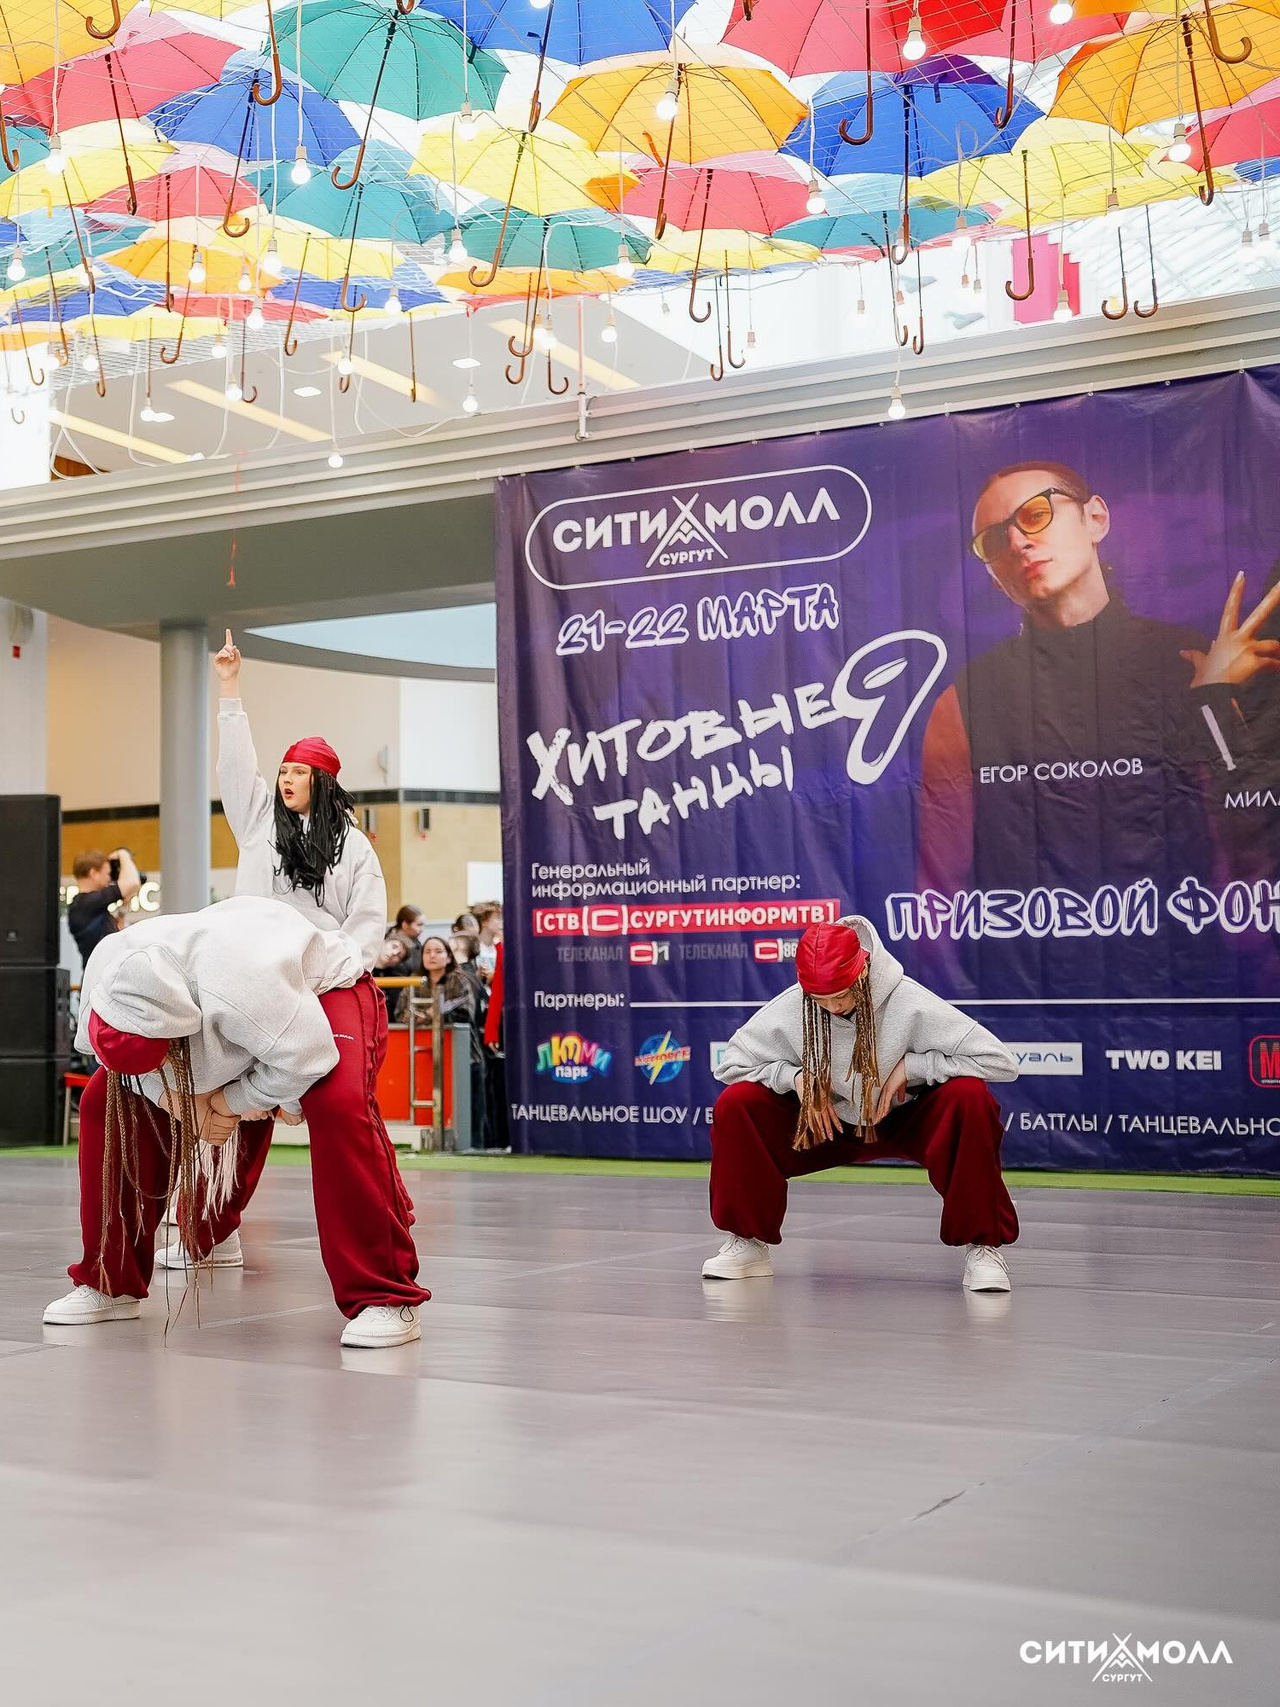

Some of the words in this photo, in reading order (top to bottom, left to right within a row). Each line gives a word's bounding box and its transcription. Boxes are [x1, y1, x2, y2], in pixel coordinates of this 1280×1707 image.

[552, 508, 667, 553] СИТИ
[705, 487, 841, 534] МОЛЛ
[658, 548, 715, 566] СУРГУТ
[555, 602, 689, 656] 21-22
[697, 582, 840, 642] МАРТА
[526, 682, 837, 806] ХИТОВЫЕ
[979, 764, 1028, 784] ЕГОР
[1033, 757, 1143, 781] СОКОЛОВ
[593, 746, 795, 842] ТАНЦЫ
[1224, 789, 1280, 809] МИЛ
[531, 857, 651, 881] Генеральный
[531, 875, 707, 901] информационный
[711, 874, 801, 895] партнер:
[885, 876, 1159, 941] ПРИЗОВОЙ
[557, 945, 623, 963] ТЕЛЕКАНАЛ
[679, 943, 748, 961] ТЕЛЕКАНАЛ
[534, 990, 625, 1011] Партнеры:
[1105, 1049, 1170, 1070] TWO
[1176, 1050, 1222, 1071] KEI
[555, 1066, 589, 1079] парк
[643, 1106, 689, 1125] ШОУ
[1020, 1112, 1098, 1132] БАТТЛЫ
